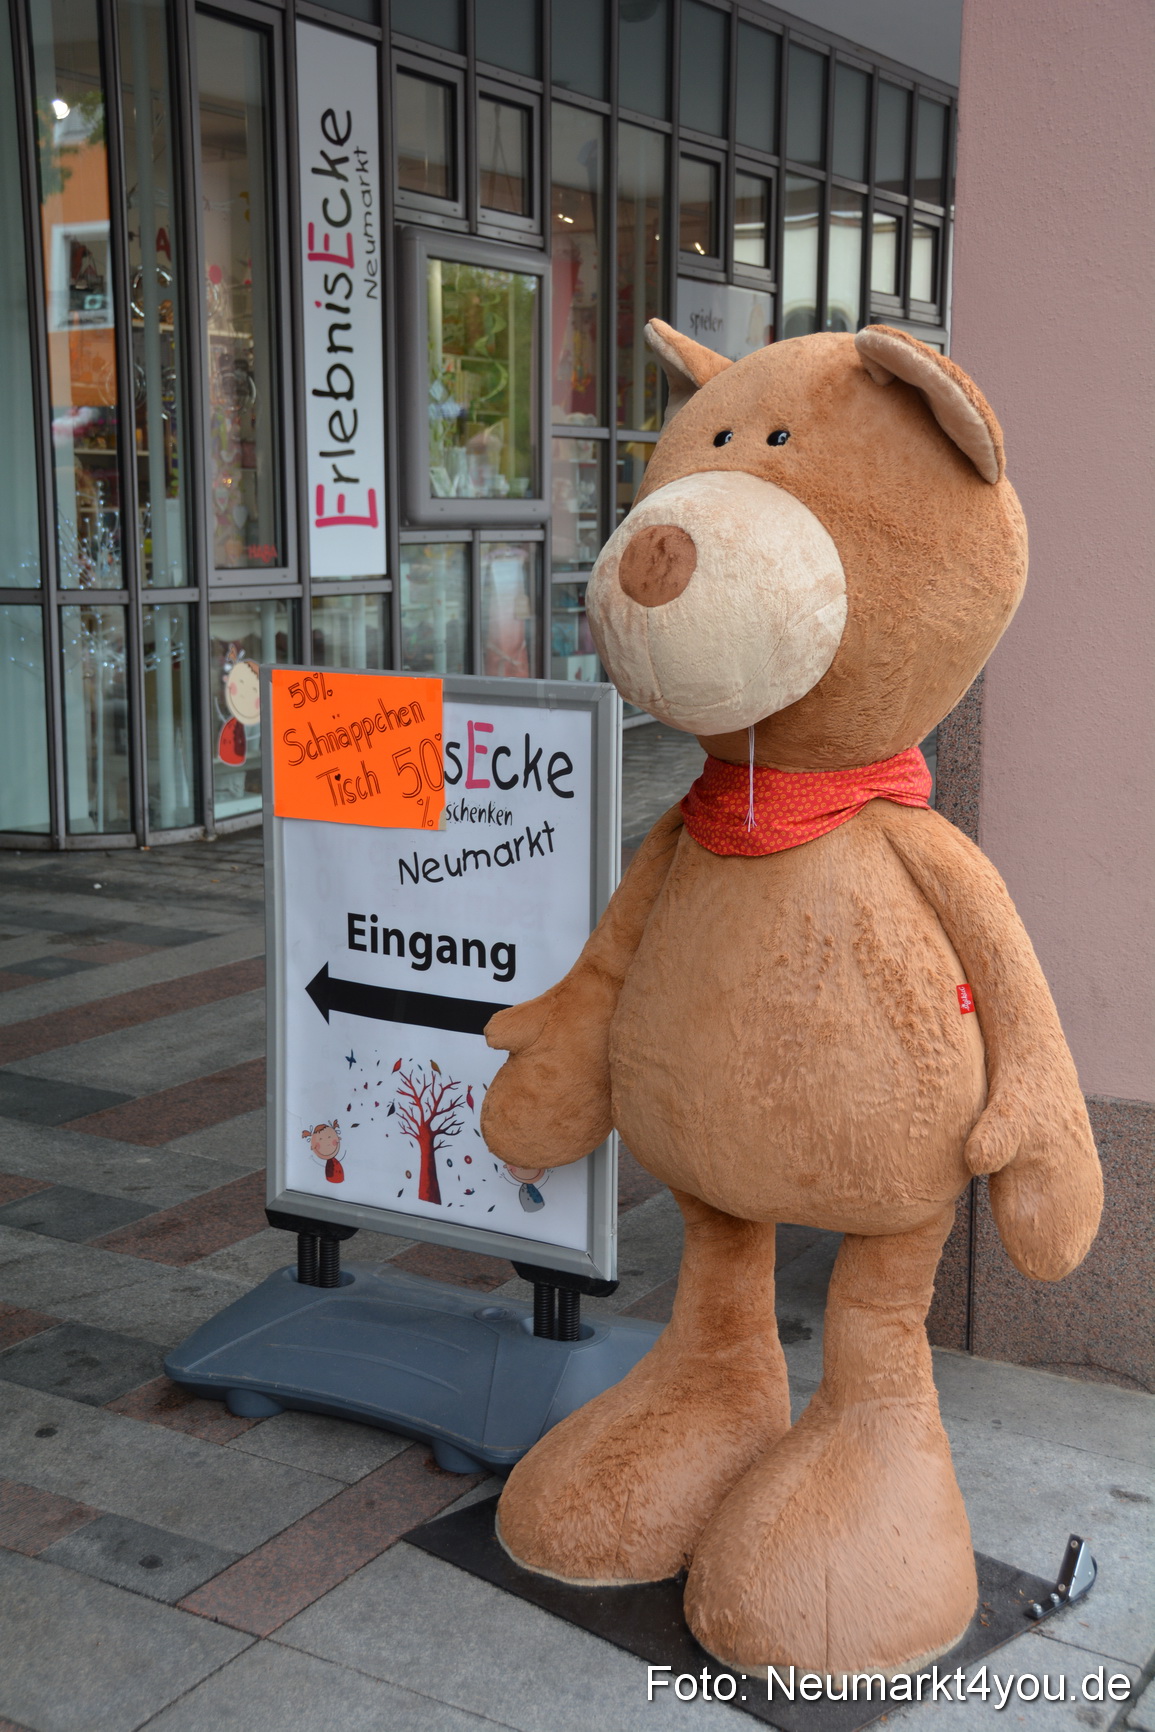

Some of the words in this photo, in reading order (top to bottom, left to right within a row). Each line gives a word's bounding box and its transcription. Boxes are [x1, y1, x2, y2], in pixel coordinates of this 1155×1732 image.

[353, 146, 379, 300] Neumarkt
[307, 108, 379, 529] ErlebnisEcke
[287, 672, 334, 709] 50%
[282, 697, 426, 767] Schnäppchen
[315, 760, 382, 807] Tisch
[445, 797, 513, 827] schenken
[398, 820, 555, 886] Neumarkt
[347, 911, 517, 983] Eingang
